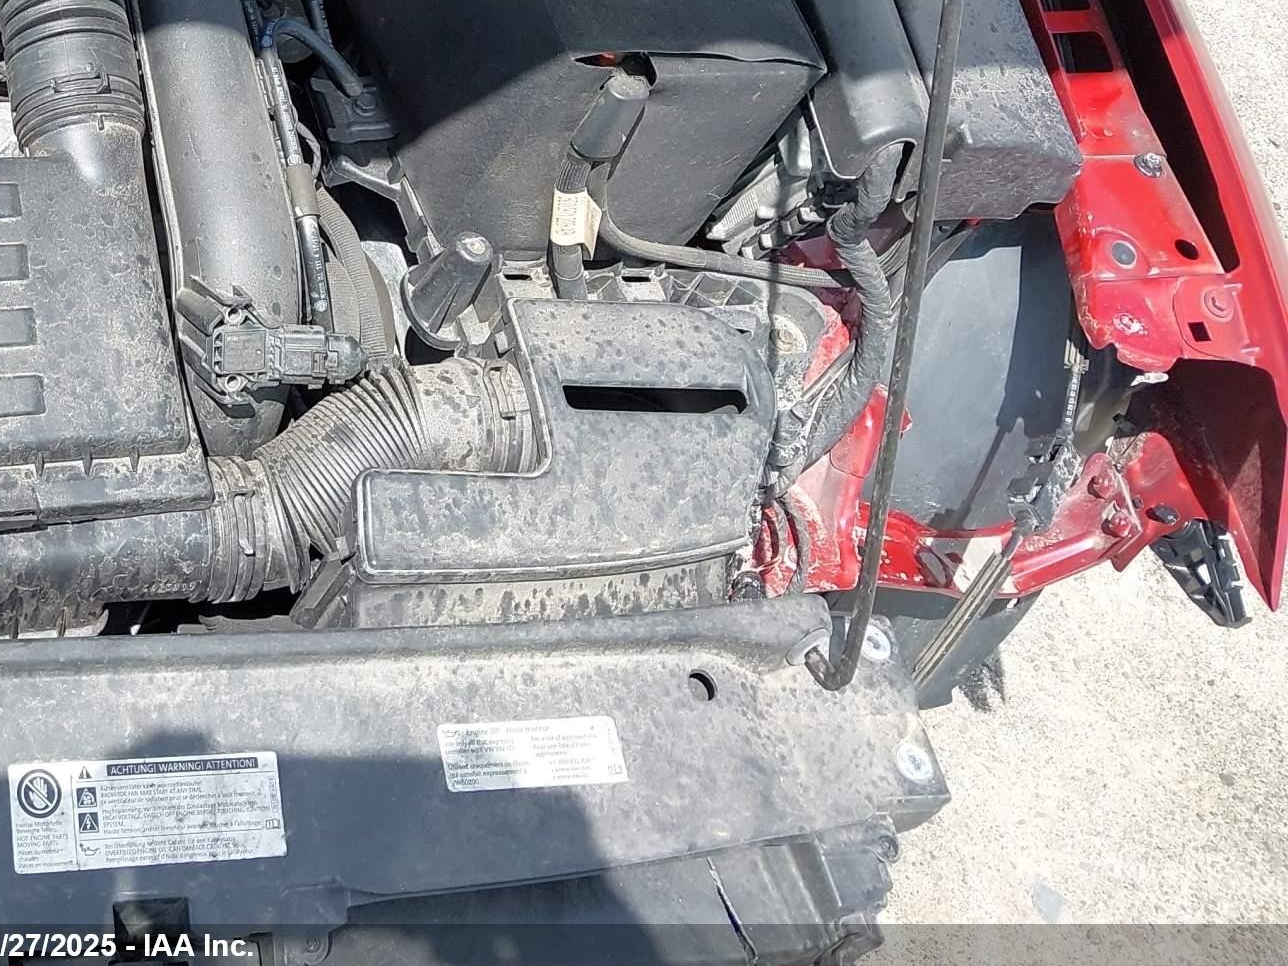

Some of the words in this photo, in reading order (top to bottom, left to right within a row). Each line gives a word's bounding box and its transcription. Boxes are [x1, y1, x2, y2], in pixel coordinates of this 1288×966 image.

[110, 764, 156, 774] ACHTUNG!
[158, 761, 204, 772] WARNING!
[205, 759, 256, 770] ATTENTION!
